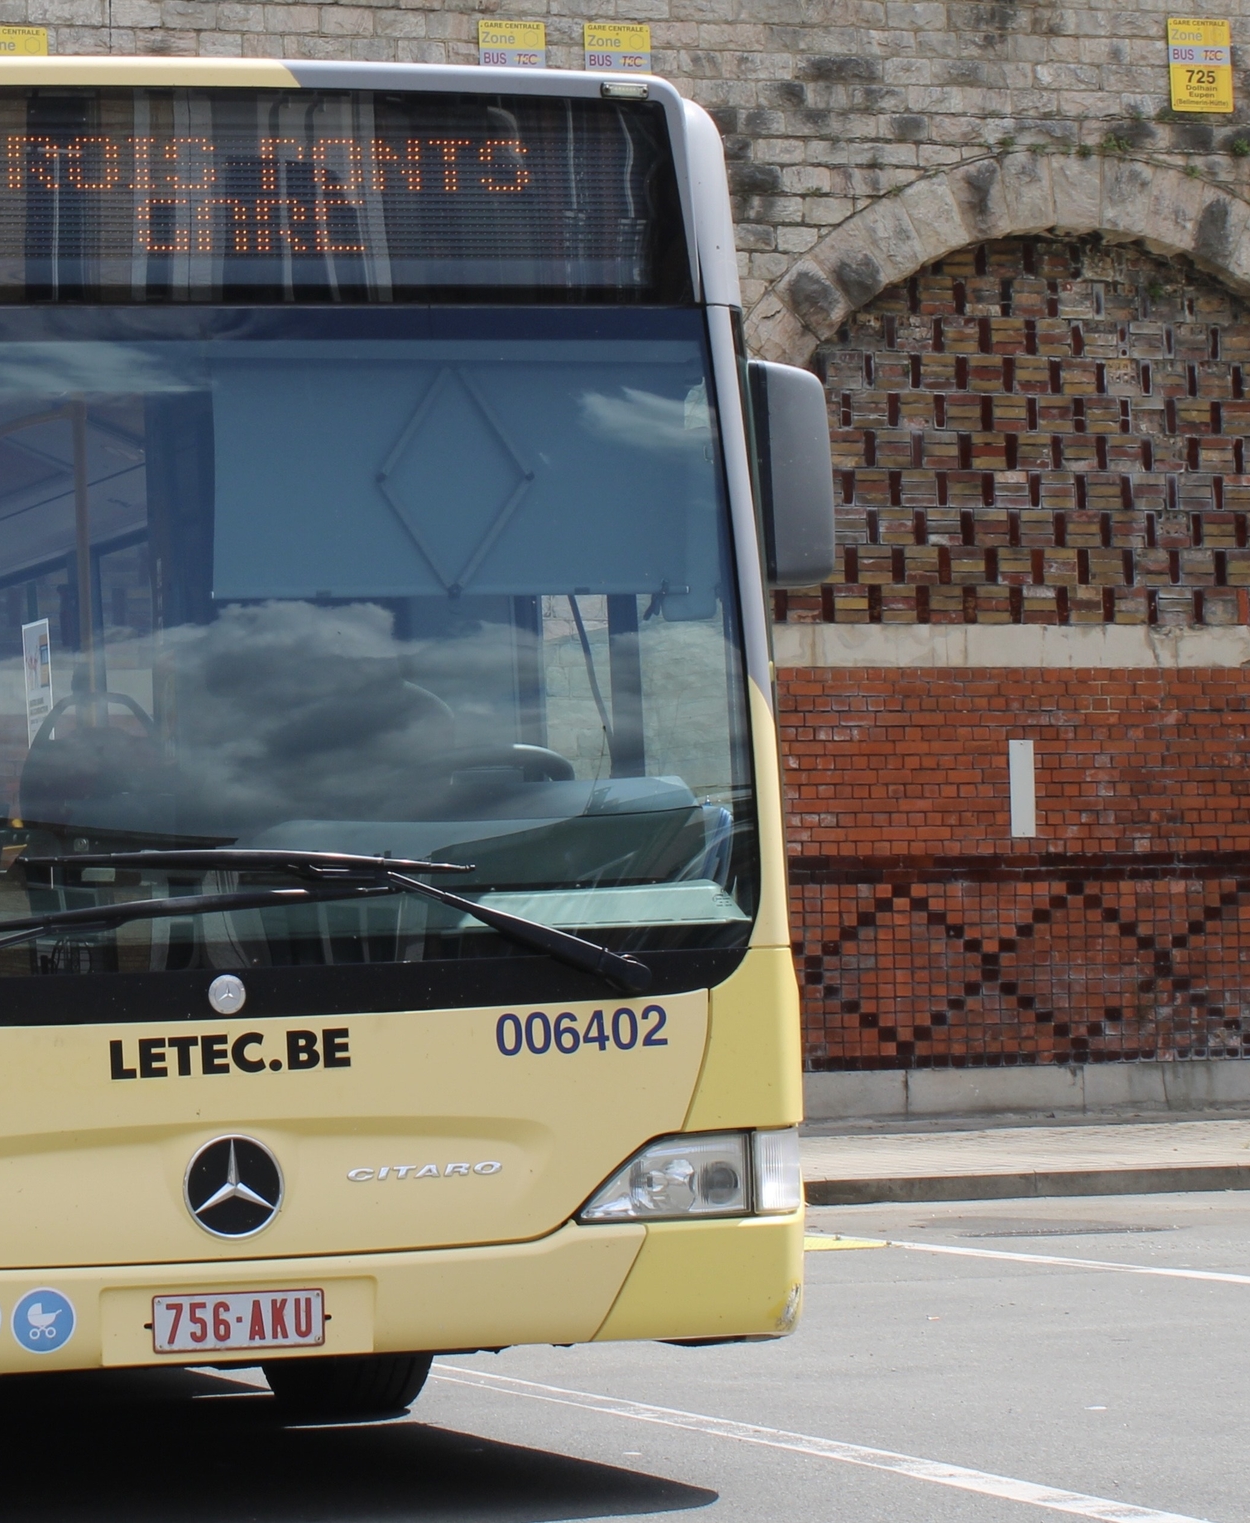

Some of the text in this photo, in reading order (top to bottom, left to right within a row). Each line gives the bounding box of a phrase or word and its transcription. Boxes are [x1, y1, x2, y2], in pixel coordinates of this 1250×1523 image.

[2, 28, 40, 36] CENTRALE
[608, 25, 644, 33] CENTRALE
[1171, 28, 1202, 41] Zone
[481, 32, 515, 44] Zone
[587, 34, 621, 48] Zone
[484, 52, 538, 65] BUS TEC
[589, 54, 643, 68] BUS TEC
[1173, 48, 1223, 61] BUS TEC
[1186, 70, 1216, 84] 725
[1186, 84, 1218, 92] Dolhain
[260, 137, 529, 192] PONTS
[495, 1004, 668, 1057] 006402
[109, 1027, 352, 1081] LETEC.BE
[346, 1159, 503, 1182] CITARO
